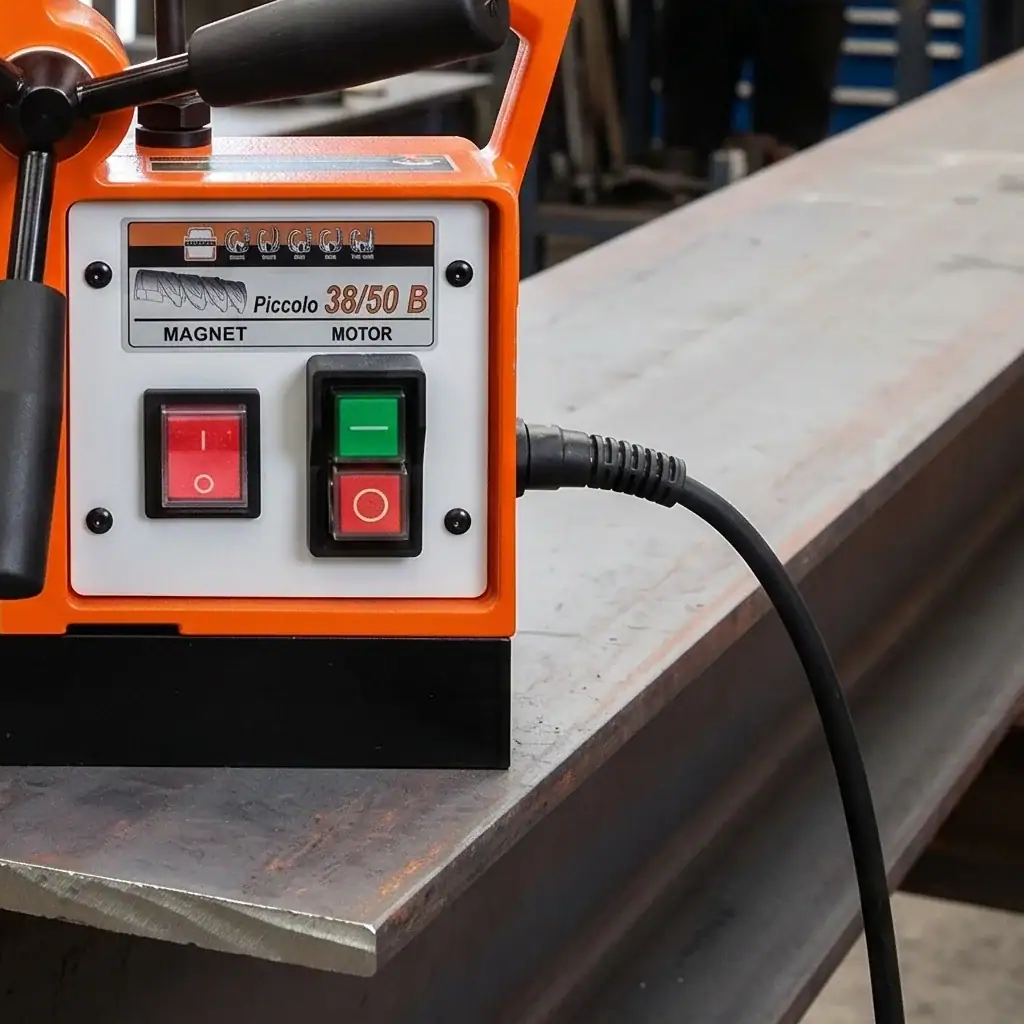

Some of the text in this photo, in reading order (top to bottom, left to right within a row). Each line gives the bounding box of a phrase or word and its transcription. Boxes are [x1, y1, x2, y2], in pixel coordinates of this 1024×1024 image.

[253, 284, 429, 315] Piccolo 38/50 B
[163, 326, 248, 342] MAGNET
[331, 326, 393, 342] MOTOR
